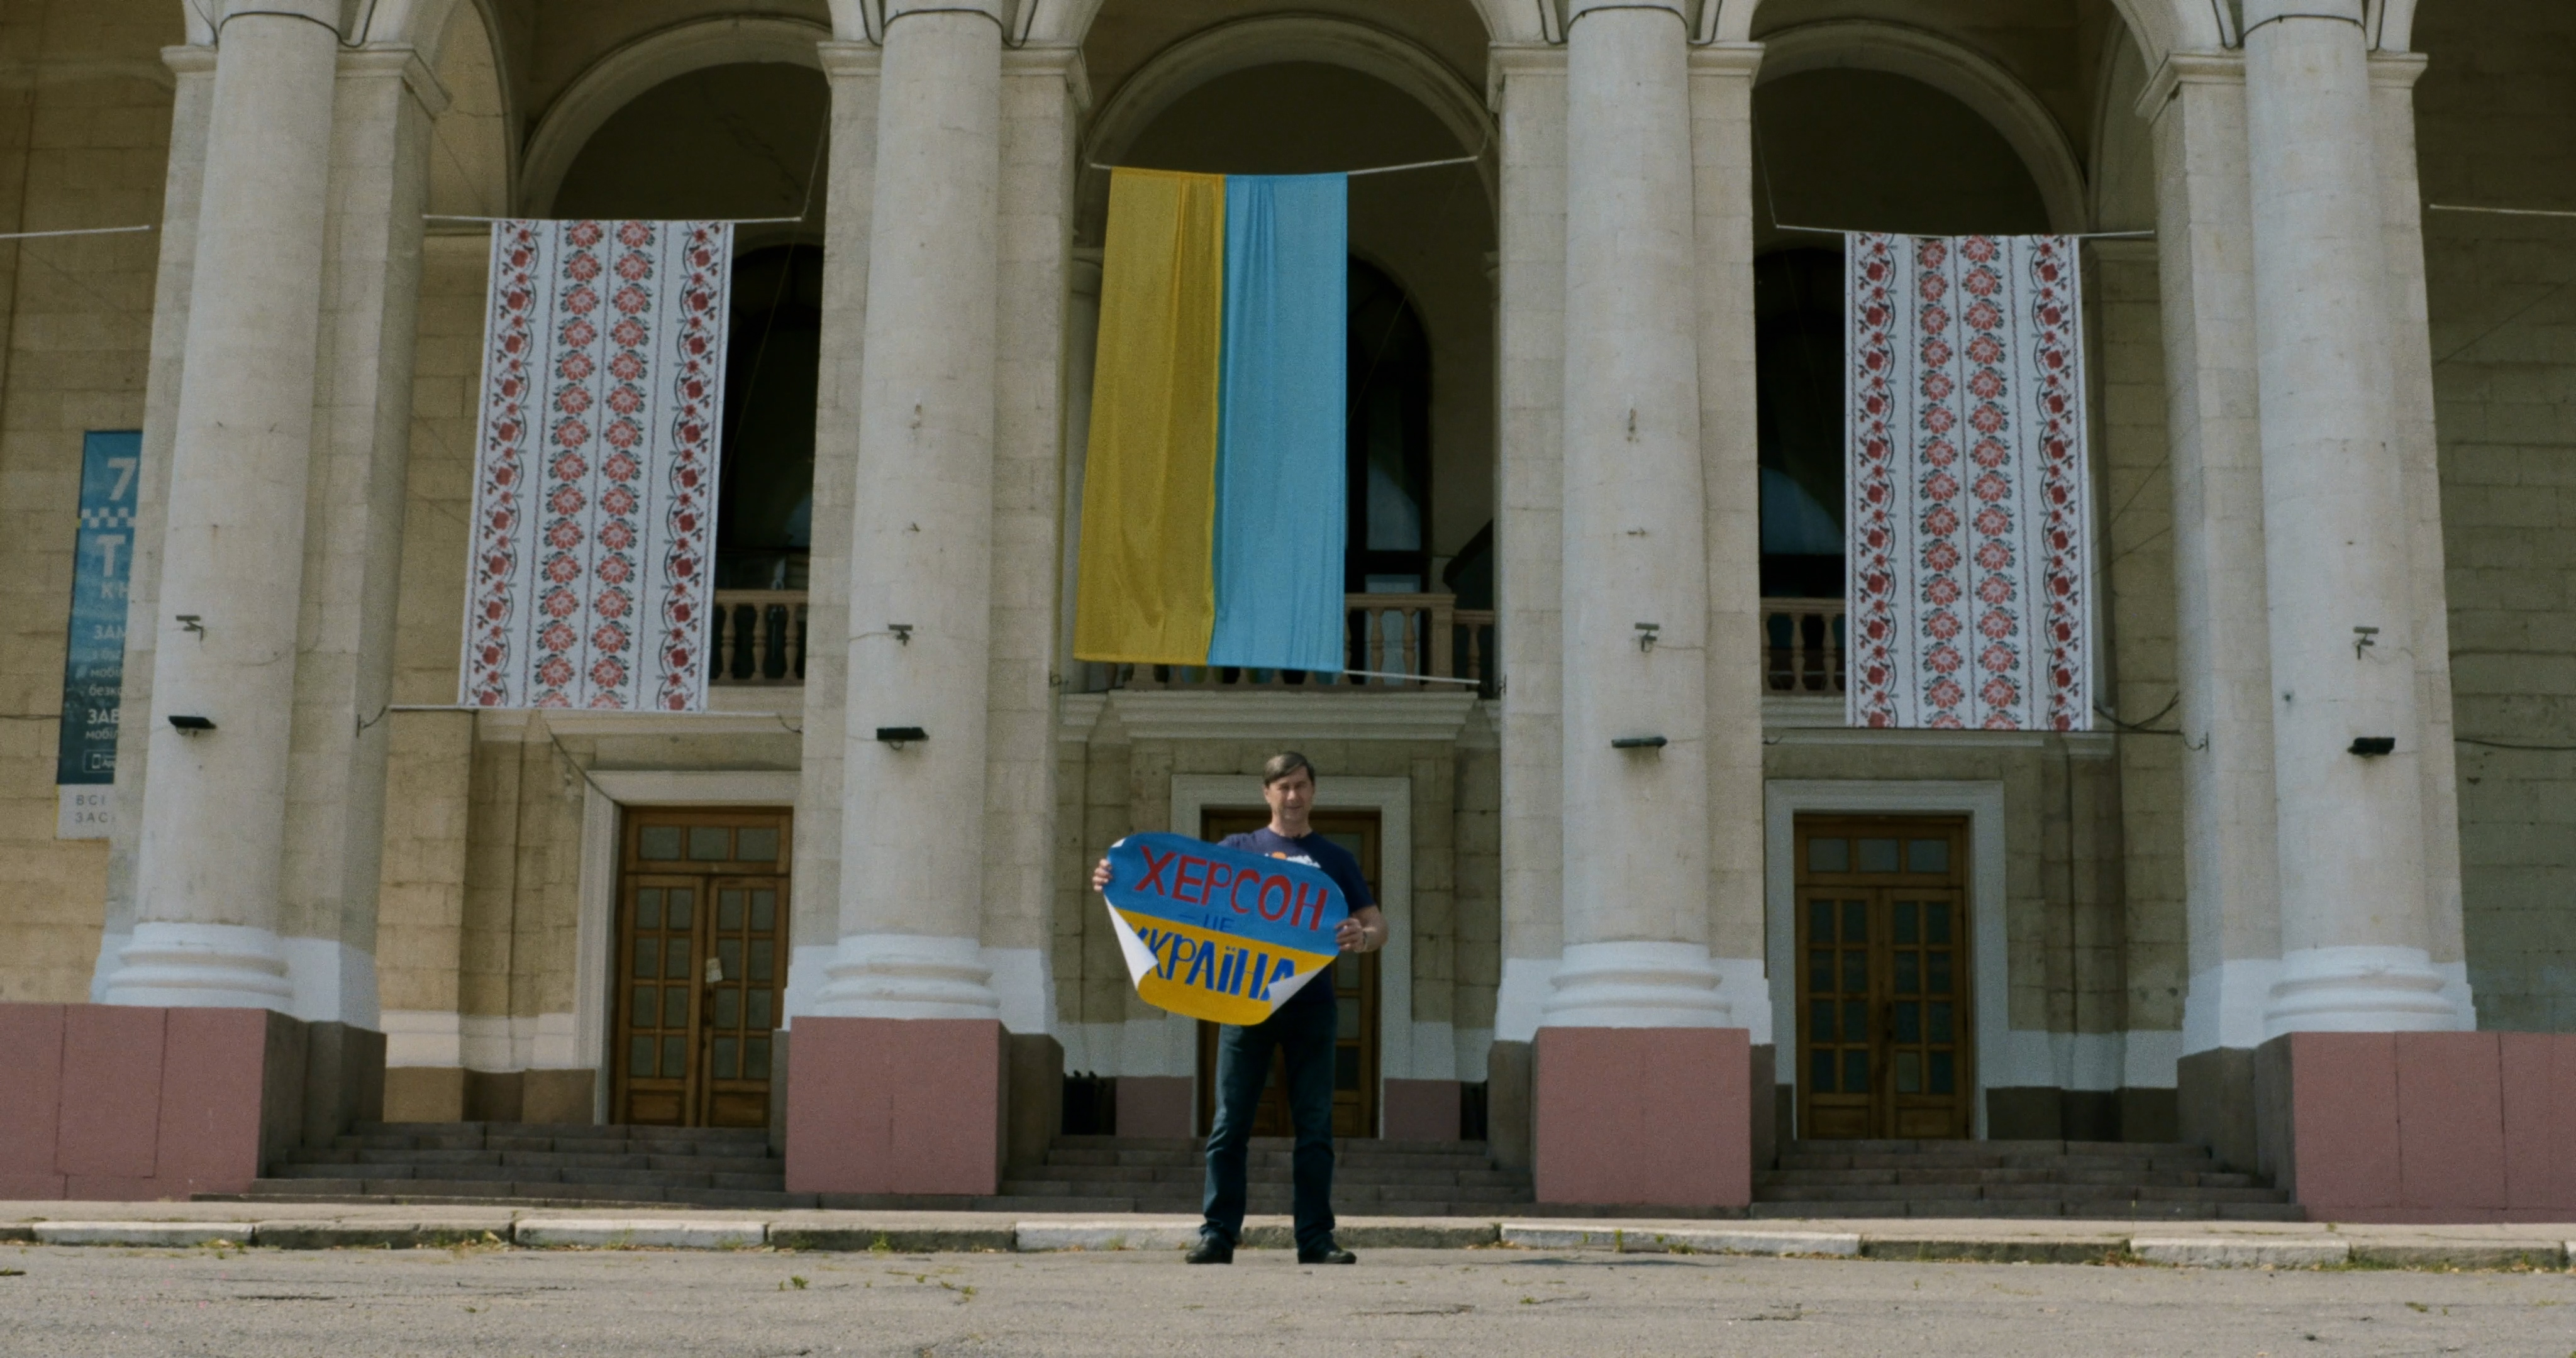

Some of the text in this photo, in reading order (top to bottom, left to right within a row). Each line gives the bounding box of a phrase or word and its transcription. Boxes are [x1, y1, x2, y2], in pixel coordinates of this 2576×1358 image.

[108, 458, 136, 501] 7
[1134, 845, 1328, 931] ХЕРСОН
[1128, 923, 1296, 1001] КРАЇНА
